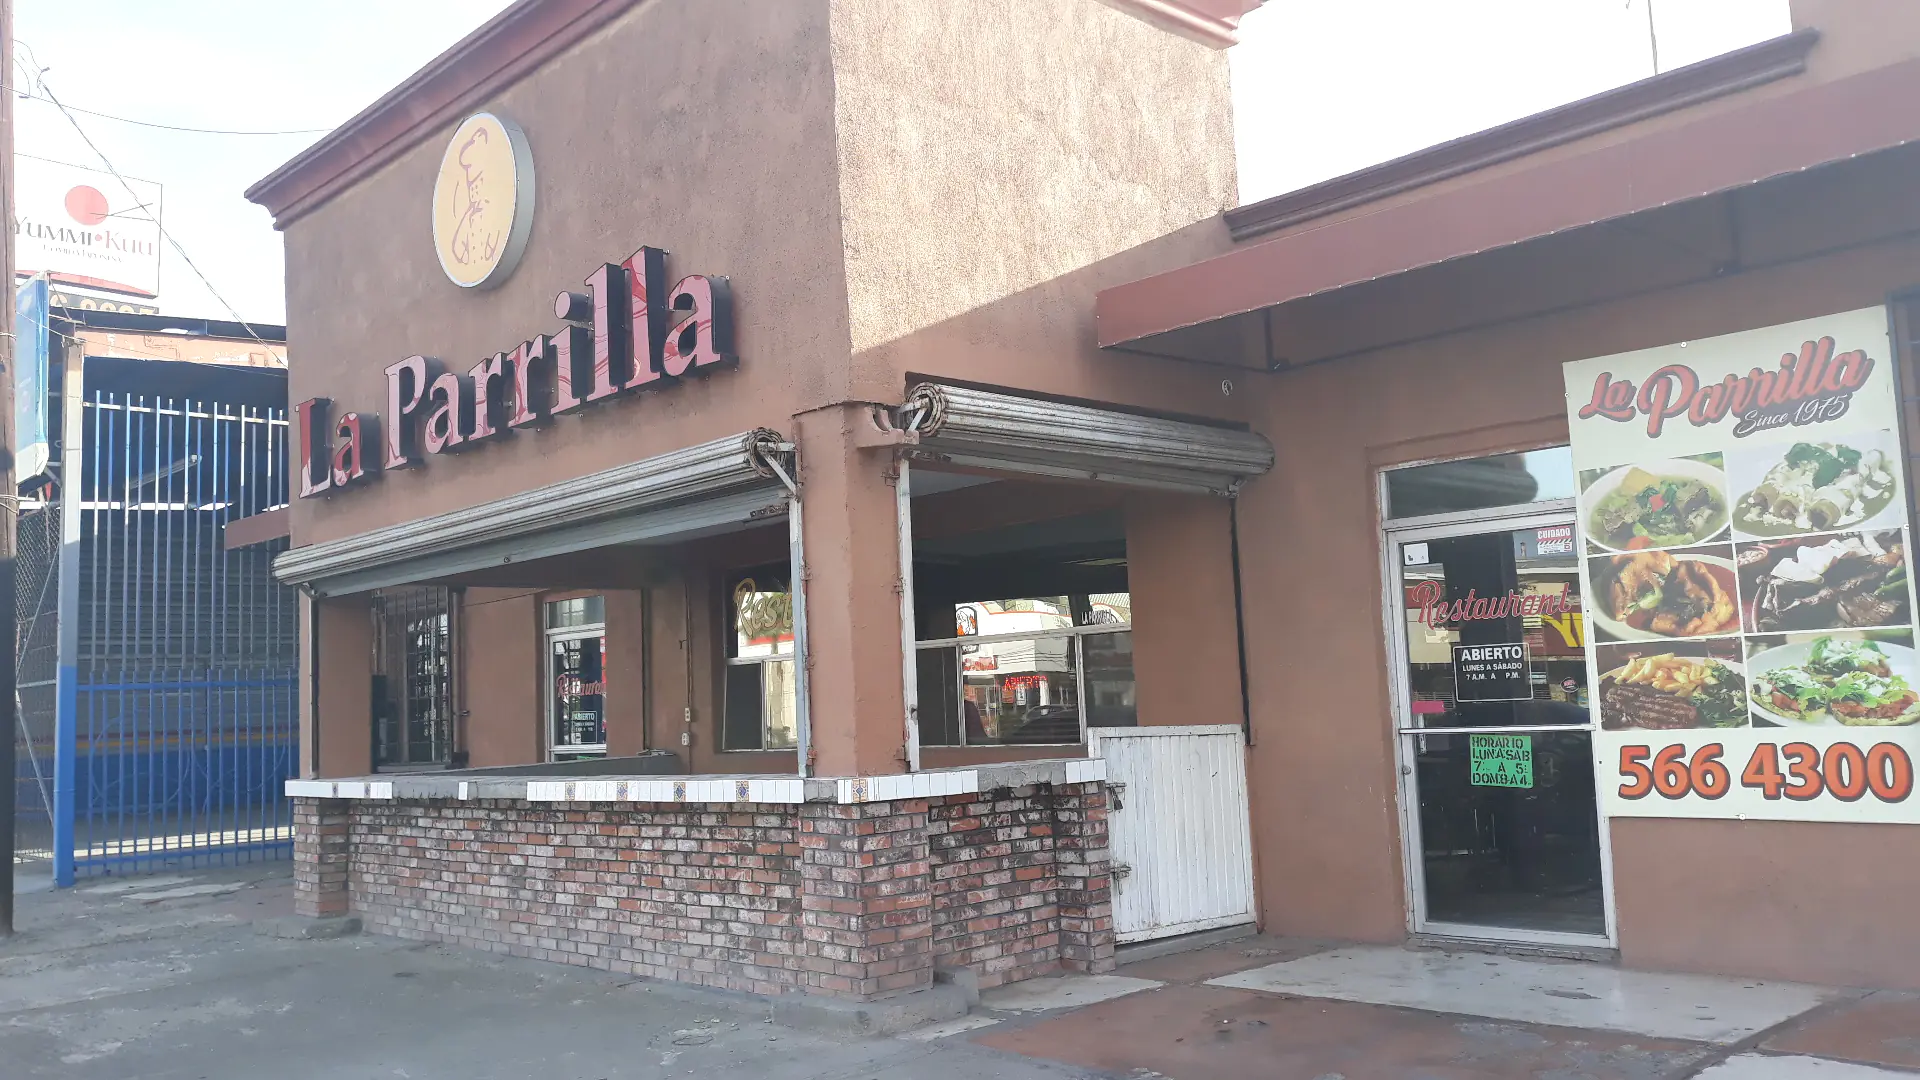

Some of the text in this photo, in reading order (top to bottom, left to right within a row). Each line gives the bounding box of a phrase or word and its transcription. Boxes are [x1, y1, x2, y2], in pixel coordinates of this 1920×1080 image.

[295, 245, 726, 499] La Parrilla
[1578, 336, 1875, 438] La Parrilla
[1737, 395, 1849, 434] Since 1975
[1537, 528, 1571, 540] CUIDADO
[1412, 580, 1573, 630] Restaurant
[1461, 646, 1523, 661] ABIERTO
[1462, 664, 1485, 672] LUNES
[1472, 736, 1523, 749] HORARIO
[1498, 762, 1506, 773] A
[1618, 742, 1914, 803] 566 4300
